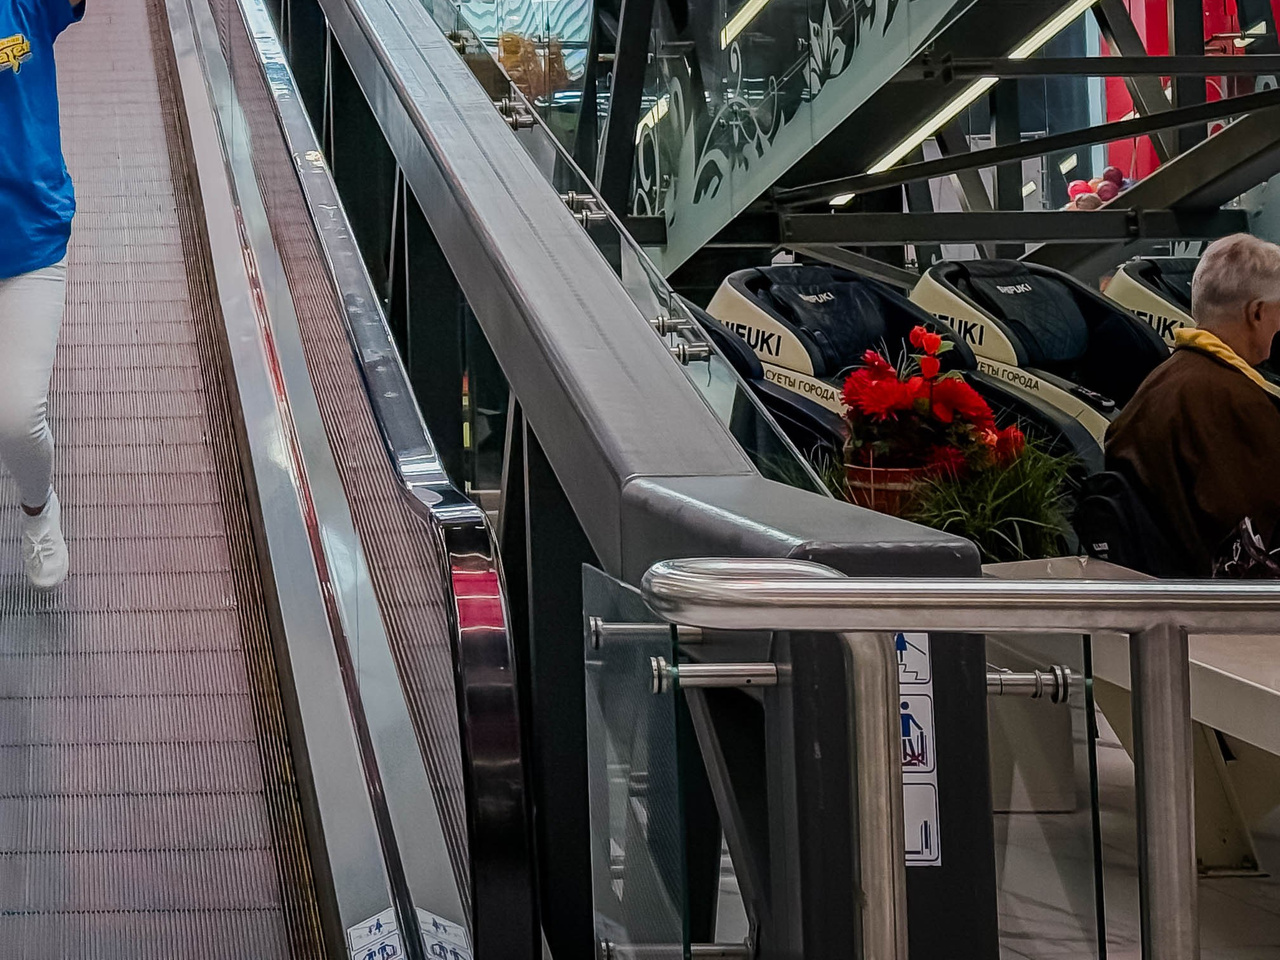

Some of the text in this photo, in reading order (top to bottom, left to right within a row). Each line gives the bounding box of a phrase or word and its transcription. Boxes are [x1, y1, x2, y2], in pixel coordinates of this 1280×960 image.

[765, 369, 836, 402] СУЕТЫ ГОРОДА
[1001, 368, 1040, 391] ГОРОДА
